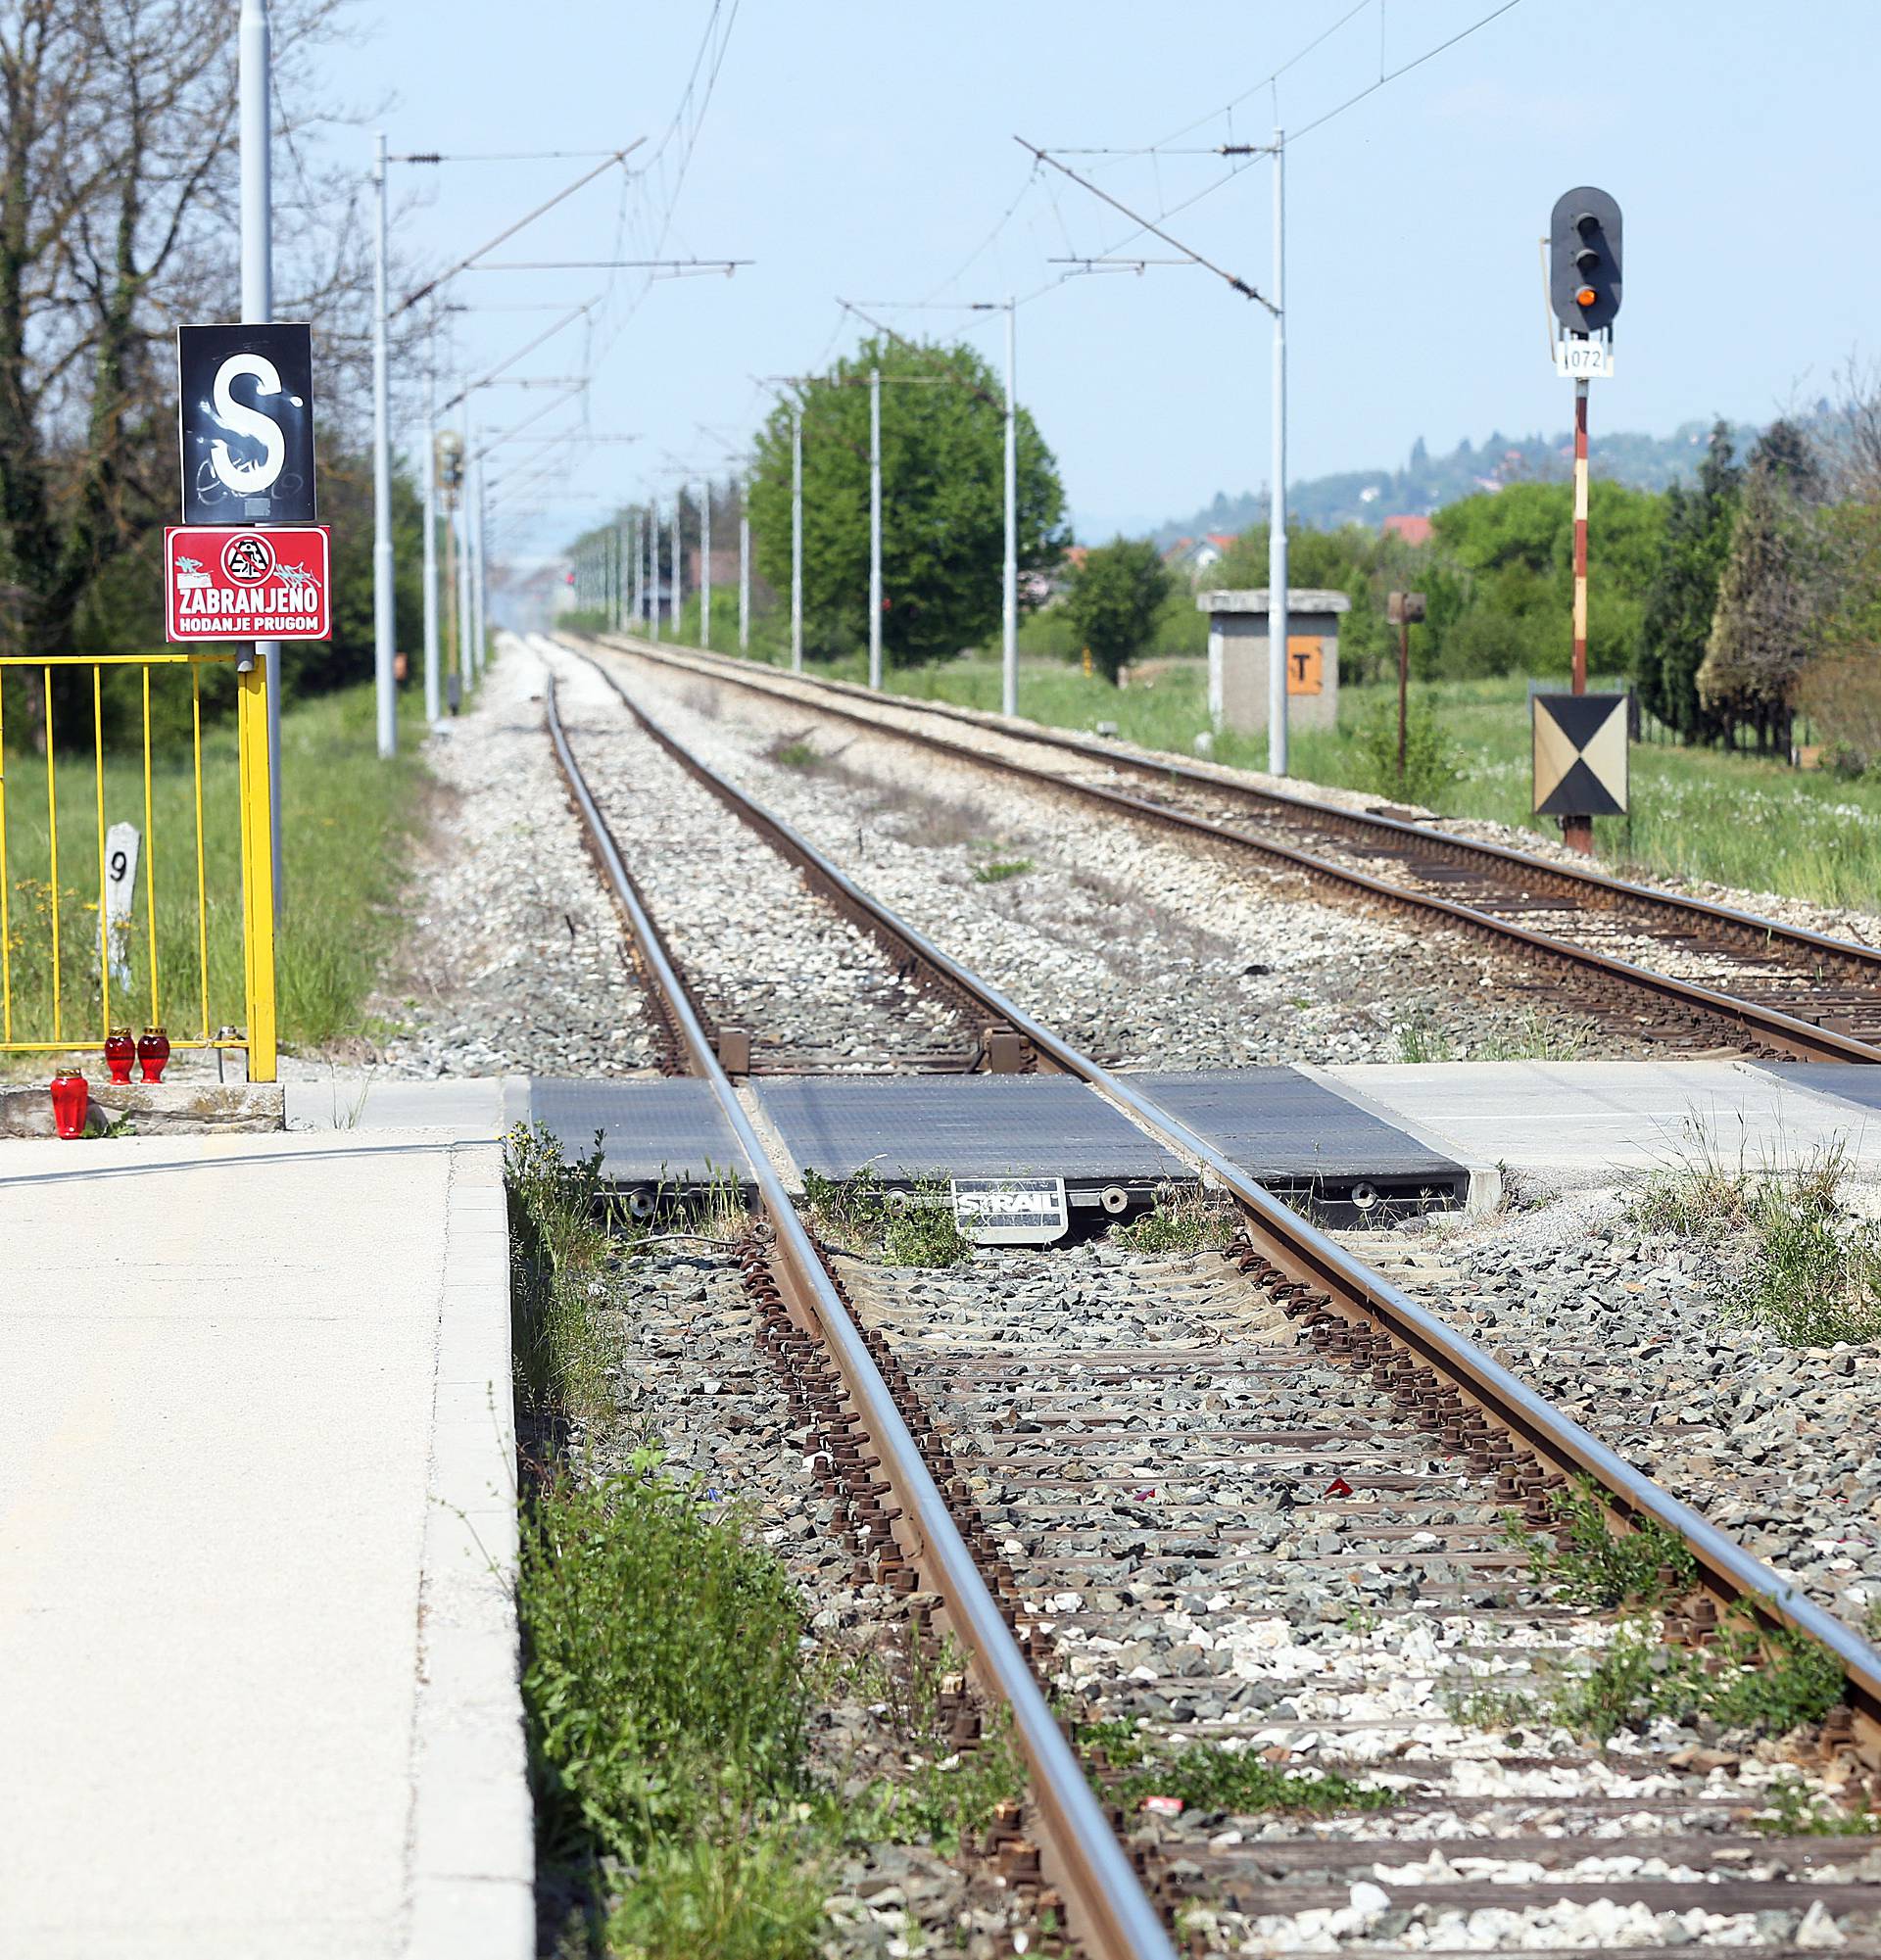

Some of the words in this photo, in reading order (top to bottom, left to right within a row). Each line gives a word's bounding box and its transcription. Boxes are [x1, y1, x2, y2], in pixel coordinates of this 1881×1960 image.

[211, 353, 285, 494] S
[179, 588, 318, 614] ZABRANJENO
[179, 617, 251, 632] HODANJE
[254, 616, 318, 631] PRUGOM
[1292, 654, 1310, 682] T
[110, 851, 126, 882] 9
